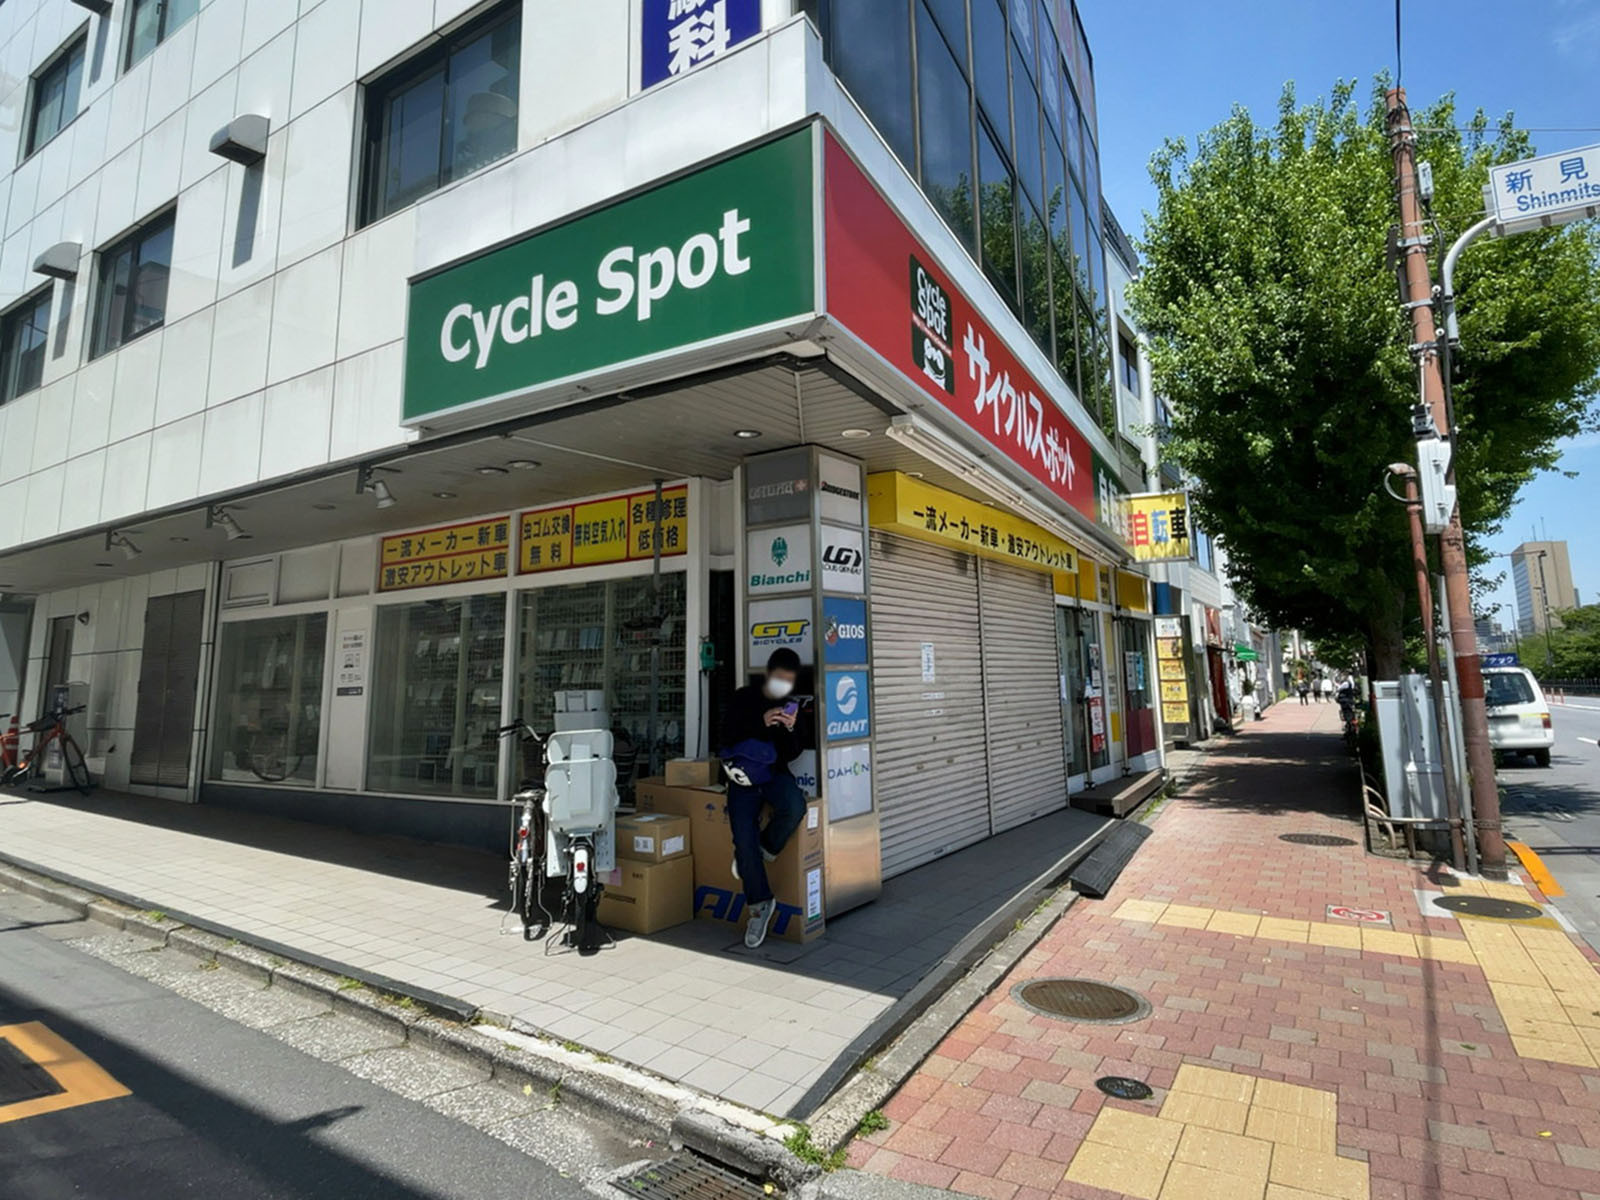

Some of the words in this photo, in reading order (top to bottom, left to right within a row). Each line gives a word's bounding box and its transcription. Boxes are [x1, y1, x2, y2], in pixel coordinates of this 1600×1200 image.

[668, 0, 730, 75] 科
[1505, 156, 1588, 194] 新見
[440, 274, 578, 369] Cycle
[596, 209, 751, 321] Spot
[917, 266, 946, 310] Cycle
[918, 288, 947, 341] Spot
[963, 321, 1075, 490] サイクルスポット
[386, 523, 507, 558] 一流メーカー新車
[574, 516, 626, 547] 無料空気入れ
[1131, 506, 1188, 546] 自転車
[384, 552, 506, 587] 激安アウトレット車
[530, 541, 562, 565] 無料
[750, 570, 810, 587] Bianchi
[751, 619, 810, 639] GT
[838, 624, 865, 639] GIOS
[827, 719, 868, 736] GIANT
